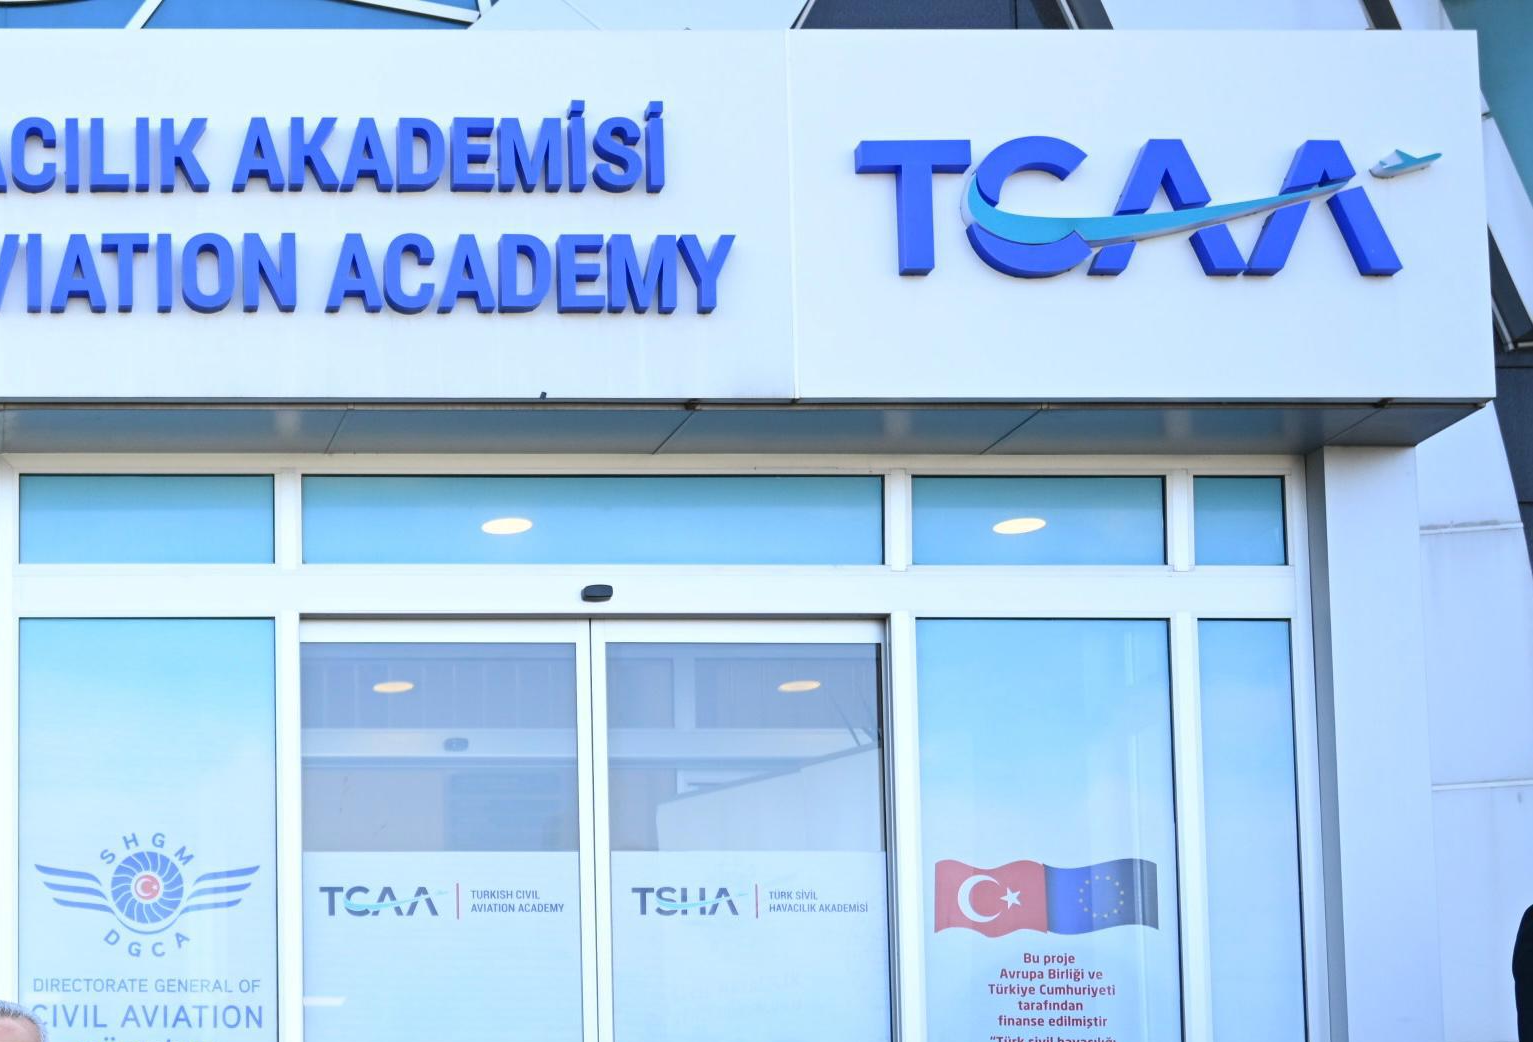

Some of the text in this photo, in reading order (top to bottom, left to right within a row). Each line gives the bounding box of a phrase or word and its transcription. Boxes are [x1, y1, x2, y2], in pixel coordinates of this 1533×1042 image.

[232, 100, 665, 194] AKADEMİSİ
[854, 135, 1403, 279] TCAA
[325, 233, 736, 315] ACADEMY
[99, 832, 194, 867] SHGM
[319, 886, 439, 916] TCAA
[470, 889, 541, 900] TURKISH CIVIL
[631, 887, 739, 916] TSHA
[768, 889, 818, 901] TÜRK SİVİL
[470, 902, 565, 914] AVIATION ACADEMY
[768, 902, 869, 914] HAVACILIK AKADEMİSİ
[103, 929, 191, 958] DGCA
[1023, 952, 1076, 966] Bu proje
[999, 968, 1103, 982] Avrupa Birliği ve
[33, 978, 261, 994] DIRECTORATE GENERAL OF
[988, 984, 1116, 998] Türkiye Cumhuriyeti
[1018, 1000, 1083, 1011] tarafından
[121, 1004, 264, 1029] AVIATION
[998, 1015, 1108, 1029] finanse edilmiştir
